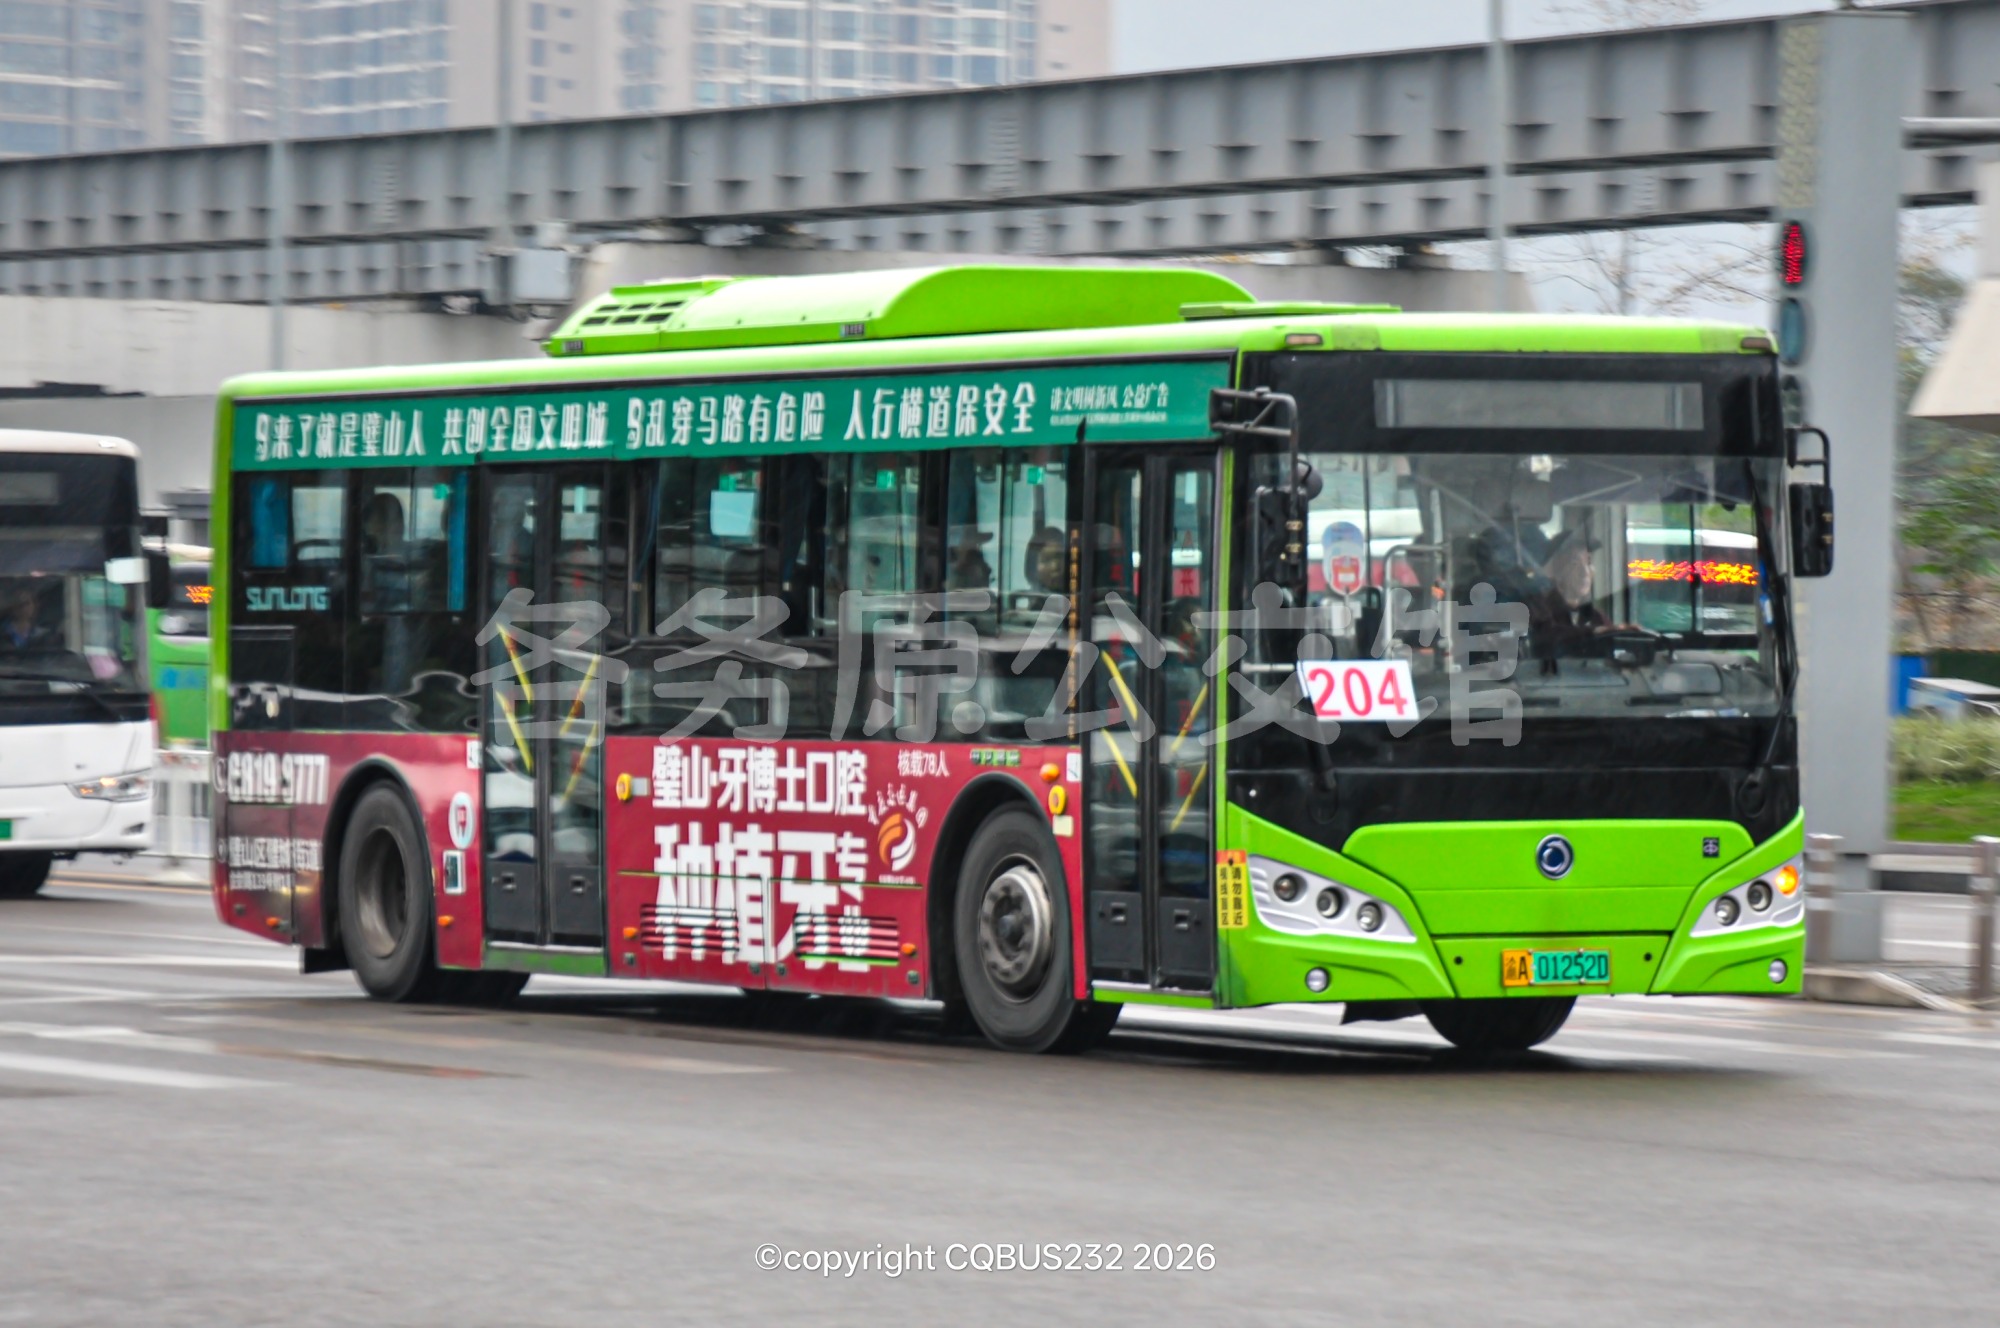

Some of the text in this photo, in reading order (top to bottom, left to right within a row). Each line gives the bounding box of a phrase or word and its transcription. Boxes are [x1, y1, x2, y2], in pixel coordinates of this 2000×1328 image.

[843, 381, 1037, 441] 人行横道保安全
[247, 587, 329, 610] SUNLONG
[1307, 667, 1408, 717] 204
